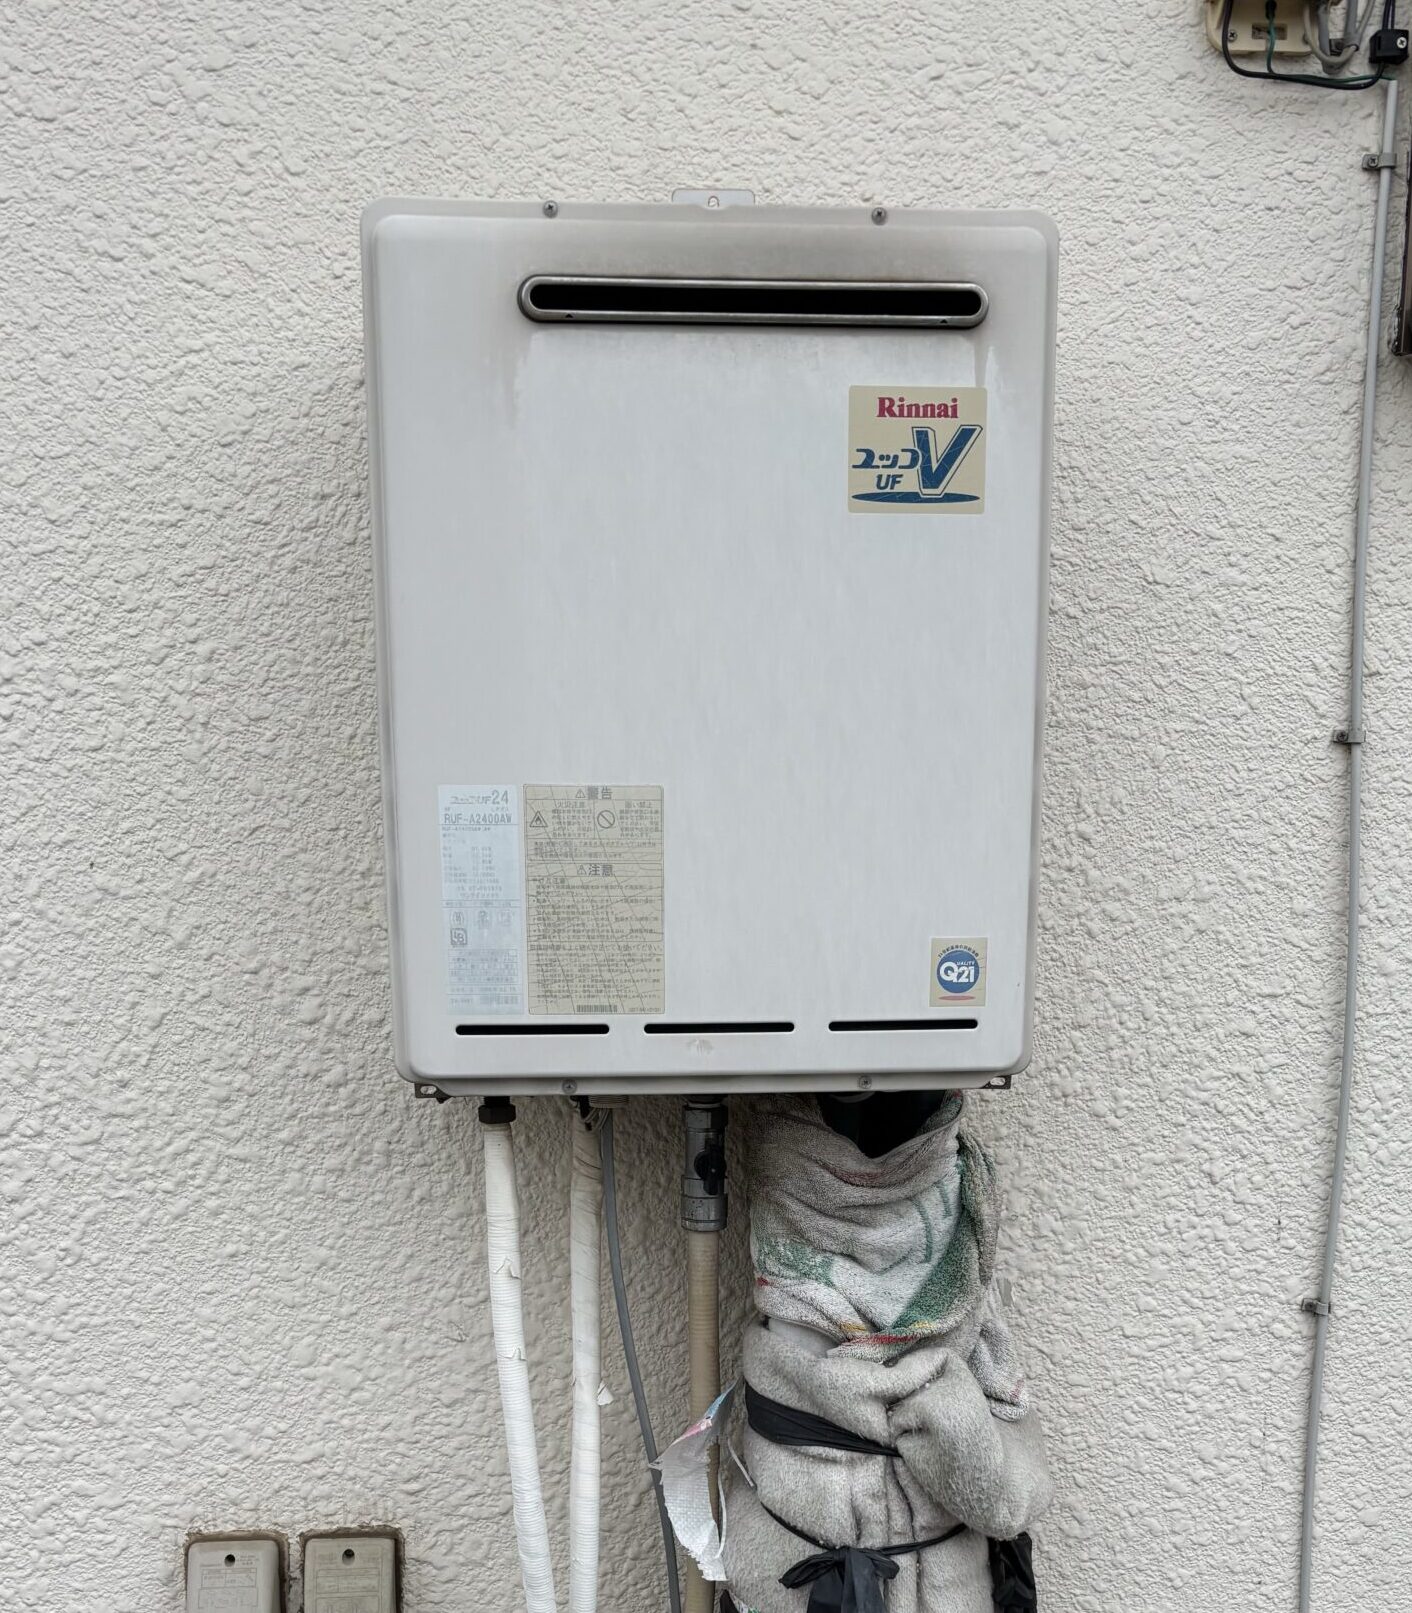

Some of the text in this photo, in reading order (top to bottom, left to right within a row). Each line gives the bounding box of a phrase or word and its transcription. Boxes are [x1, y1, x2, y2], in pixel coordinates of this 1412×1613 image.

[876, 397, 958, 418] Rinnai
[876, 474, 903, 490] UF
[588, 864, 613, 877] 注意
